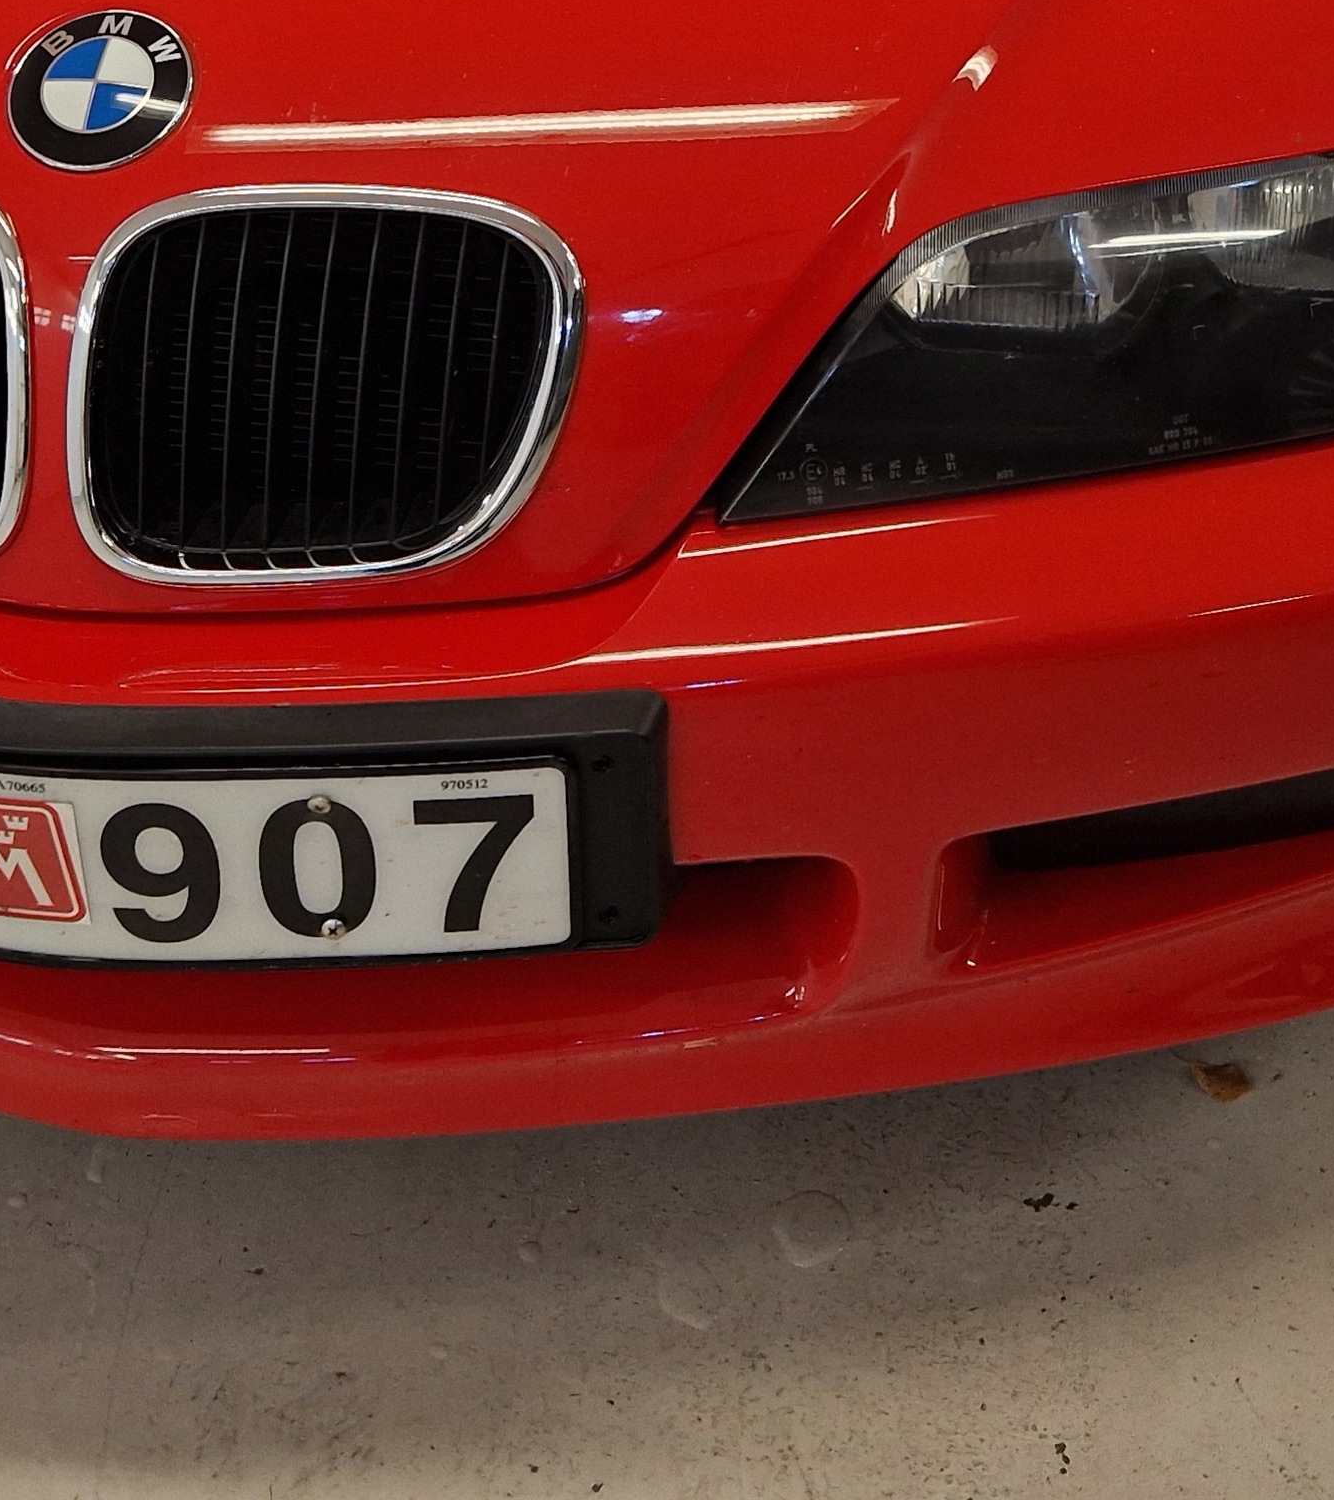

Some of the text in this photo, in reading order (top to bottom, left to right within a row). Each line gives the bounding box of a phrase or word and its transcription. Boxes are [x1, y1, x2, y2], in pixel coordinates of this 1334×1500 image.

[41, 14, 182, 63] BMW
[441, 778, 488, 790] 970512
[97, 793, 536, 943] 907
